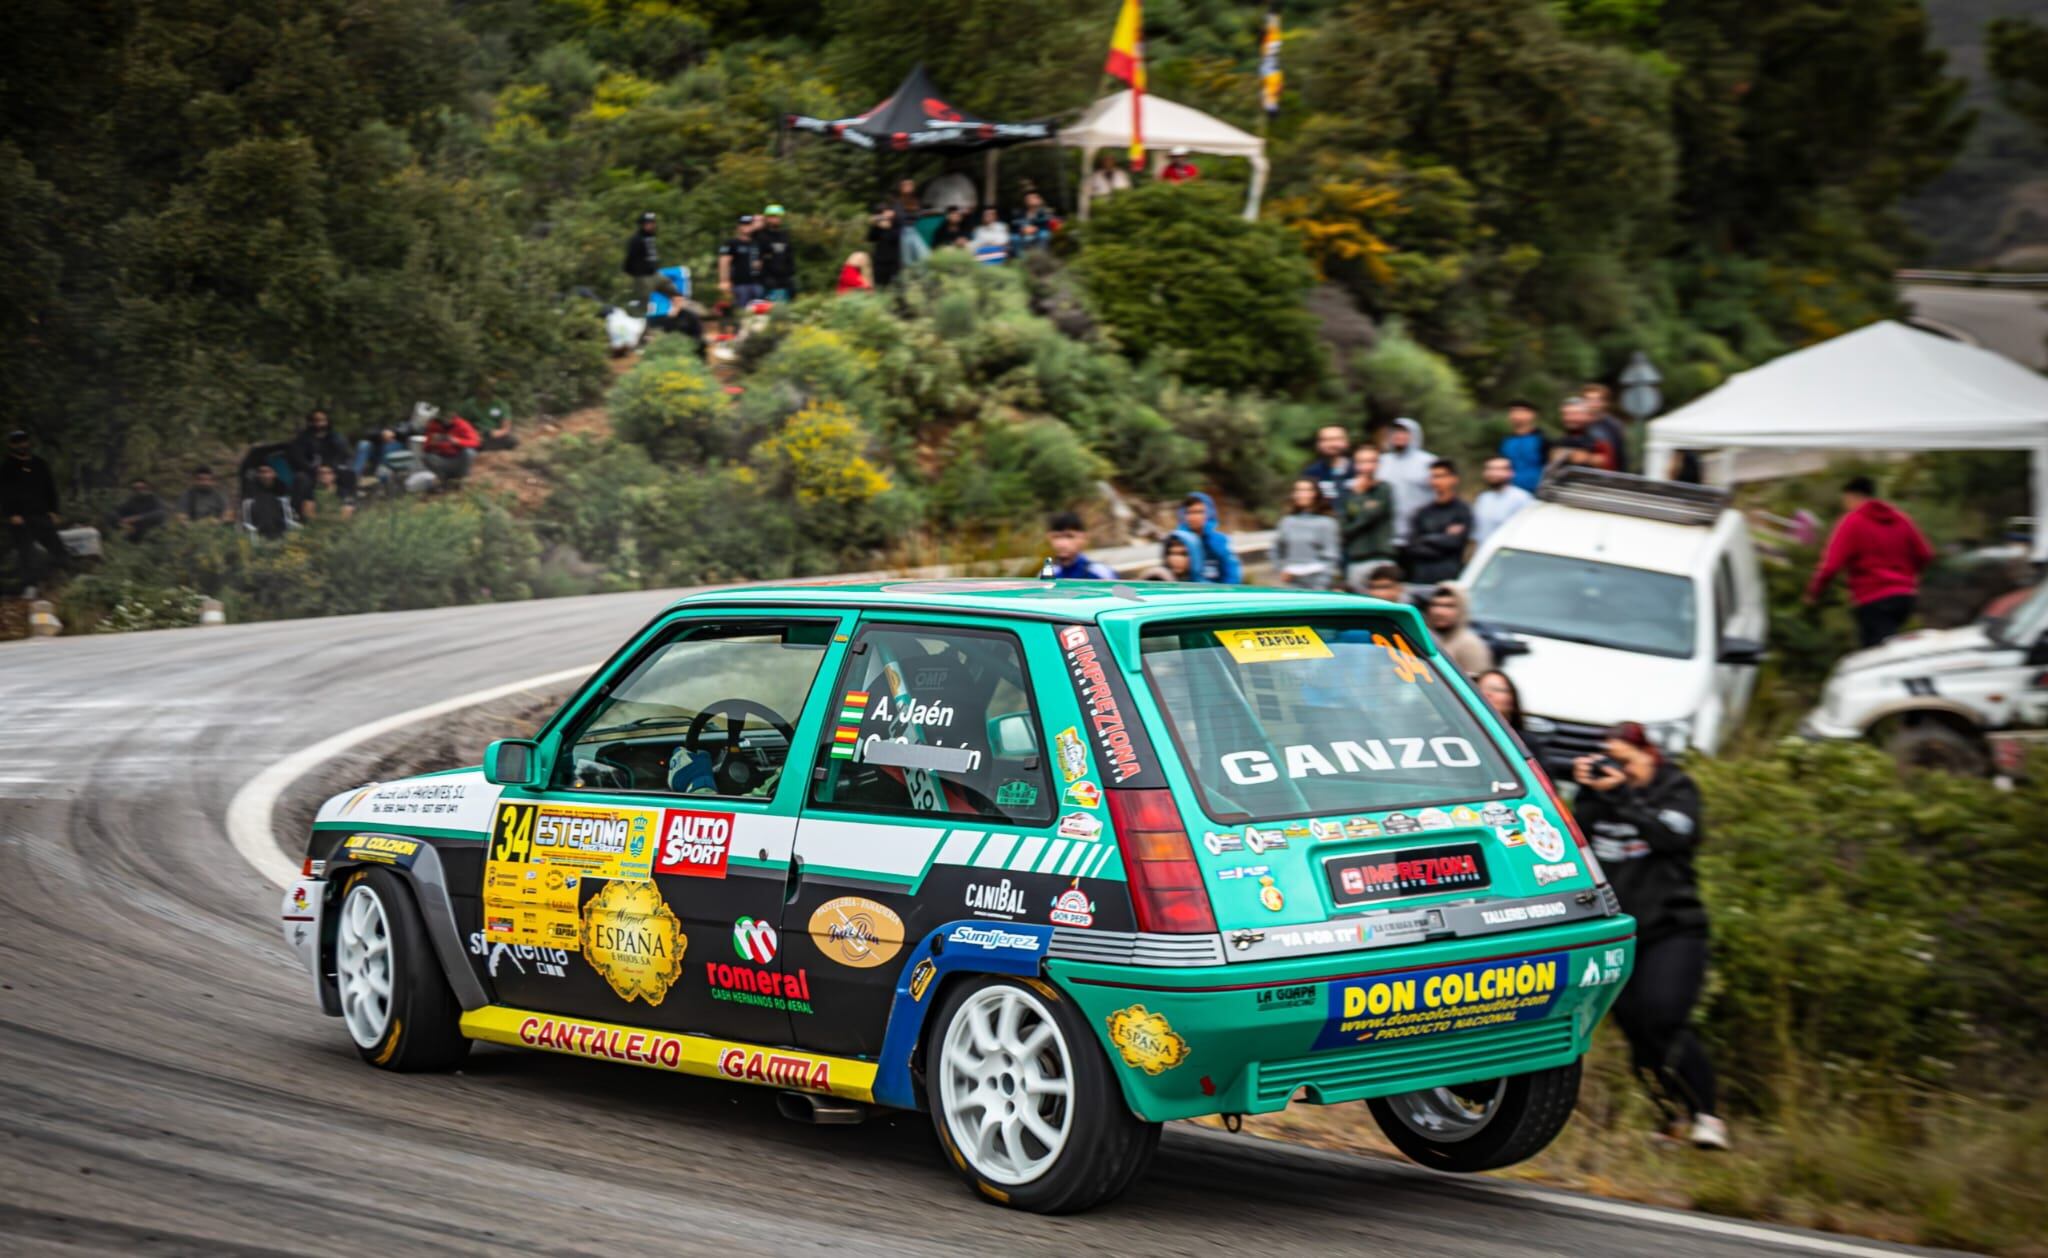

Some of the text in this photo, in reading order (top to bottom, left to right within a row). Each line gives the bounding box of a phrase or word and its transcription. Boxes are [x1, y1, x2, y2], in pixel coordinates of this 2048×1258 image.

[871, 696, 954, 727] A. Jaén
[1074, 645, 1141, 780] IMPREZIONA
[1220, 736, 1482, 785] GANZO
[496, 805, 532, 863] 34
[535, 814, 629, 848] ESTEPONA
[666, 815, 729, 845] AUTO
[661, 838, 726, 866] SPORT
[1361, 855, 1478, 885] IMPREZIONA
[596, 924, 666, 958] ESPAÑA
[705, 961, 810, 1000] romeral
[1257, 989, 1273, 1004] LA
[1344, 979, 1416, 1018] DON
[1423, 960, 1557, 1008] COLCHÓN
[711, 987, 731, 1001] CASH
[732, 990, 773, 1009] HERMANOS
[518, 1017, 682, 1069] CANTALEJO
[1374, 1011, 1518, 1041] PRODUCTO NACIONAL
